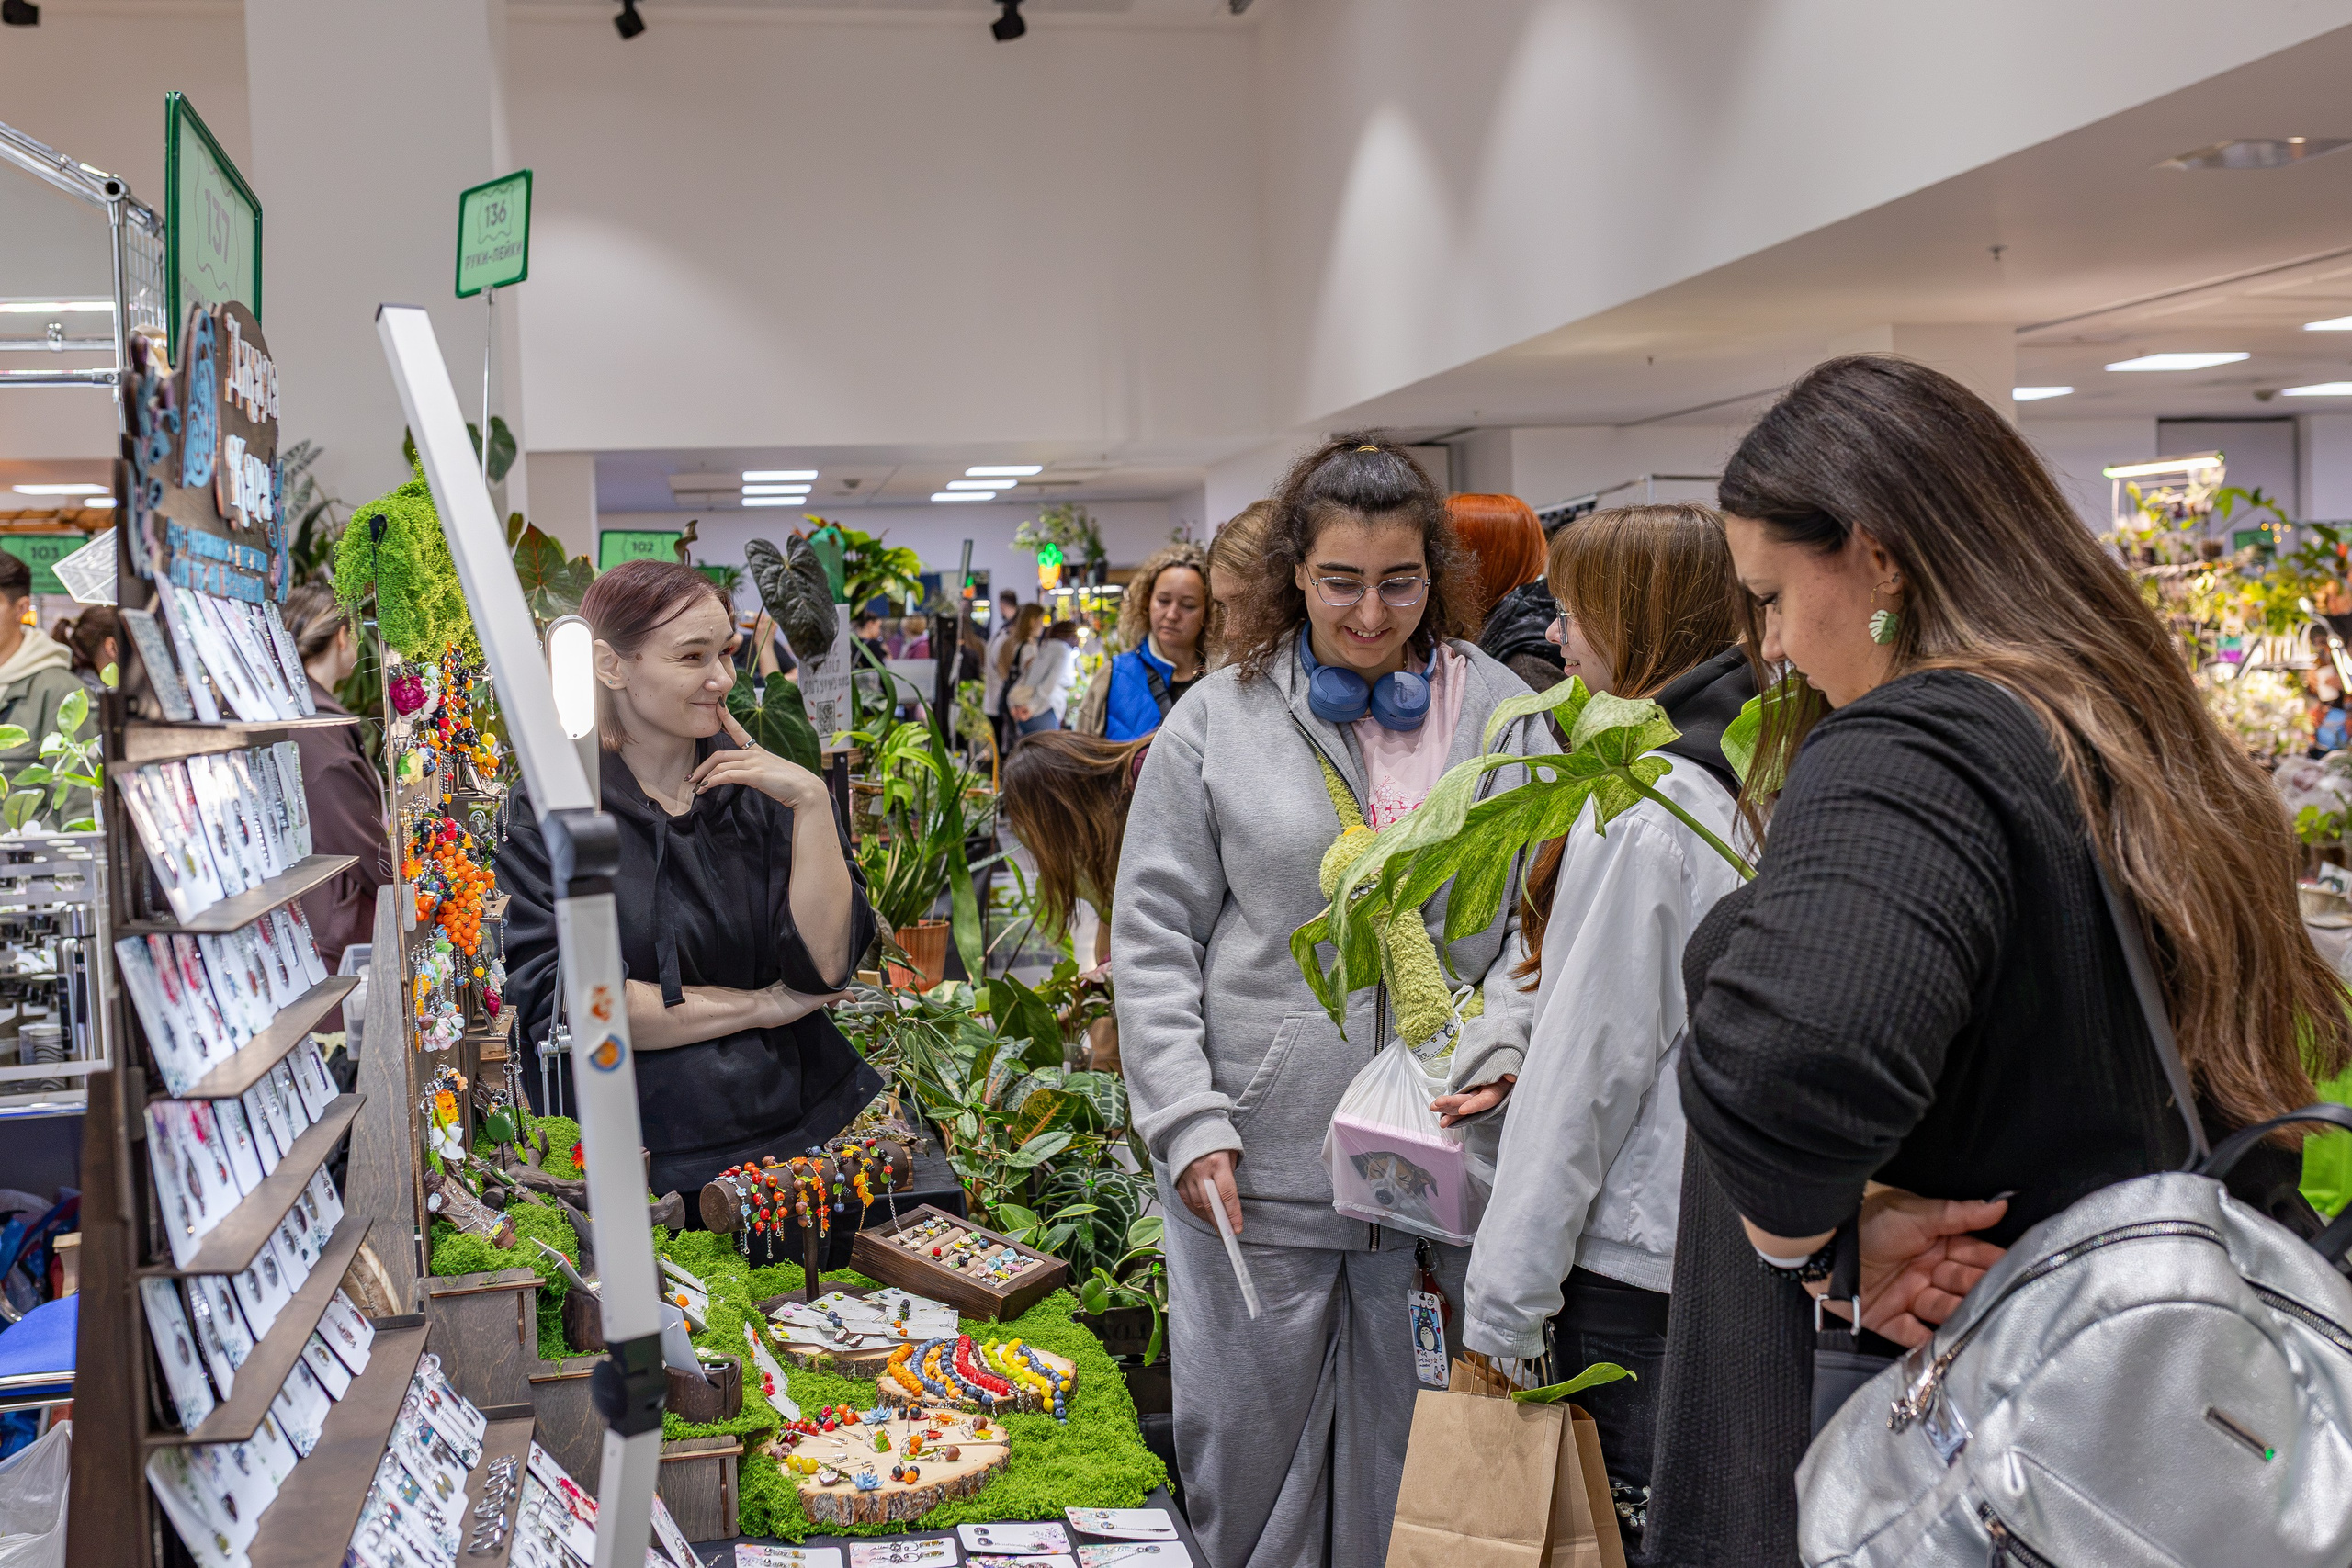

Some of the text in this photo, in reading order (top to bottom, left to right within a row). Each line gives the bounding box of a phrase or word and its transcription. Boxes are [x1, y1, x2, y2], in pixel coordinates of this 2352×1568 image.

[485, 200, 507, 229] 136
[205, 188, 230, 264] 137
[31, 546, 60, 560] 103
[631, 540, 654, 553] 102
